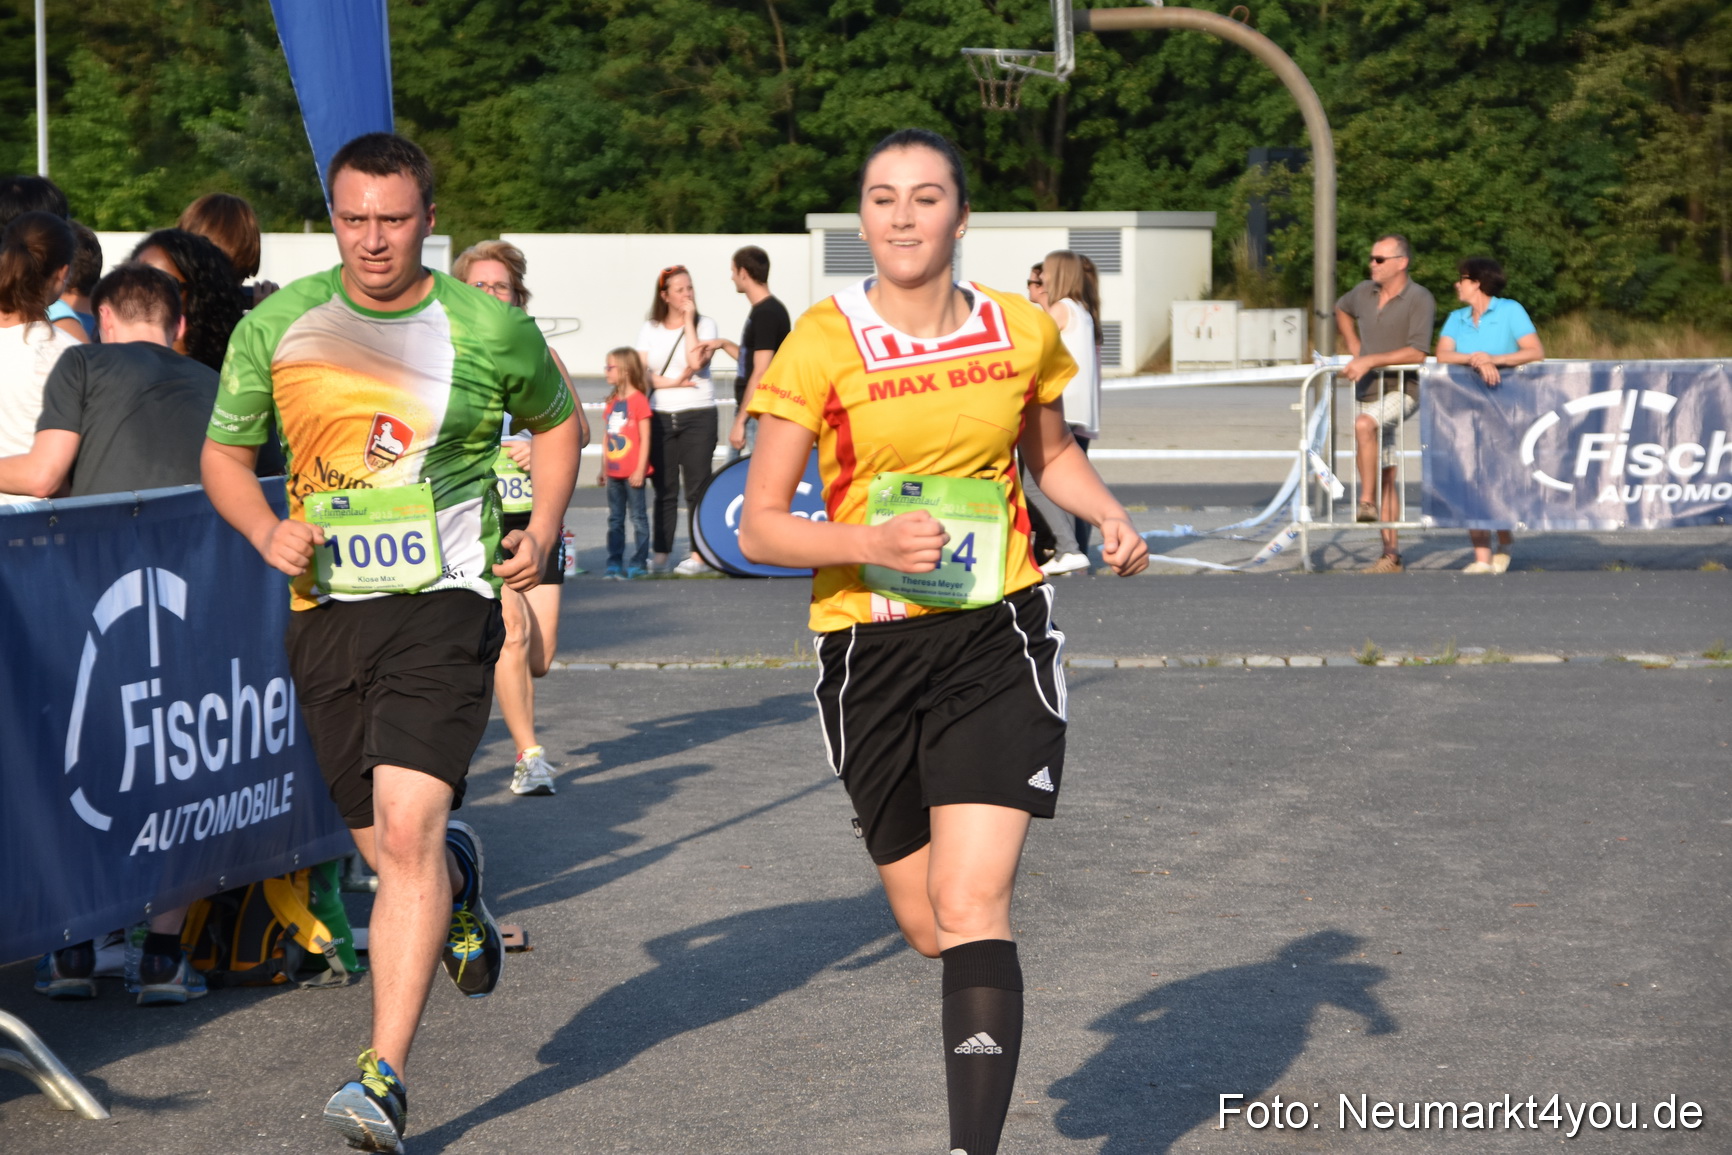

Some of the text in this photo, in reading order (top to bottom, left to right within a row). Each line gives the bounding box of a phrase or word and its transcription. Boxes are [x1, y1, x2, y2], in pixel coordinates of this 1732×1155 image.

[867, 359, 1019, 402] MAX BÖGL
[1573, 429, 1732, 477] Fisch
[890, 493, 942, 507] firmenlauf
[1596, 482, 1732, 504] AUTOMO
[323, 507, 367, 518] firmenlauf
[323, 530, 427, 568] 1006
[901, 575, 964, 590] Theresa Meyer
[1028, 778, 1055, 792] adidas
[129, 771, 295, 856] AUTOMOBILE
[953, 1045, 1003, 1054] adidas
